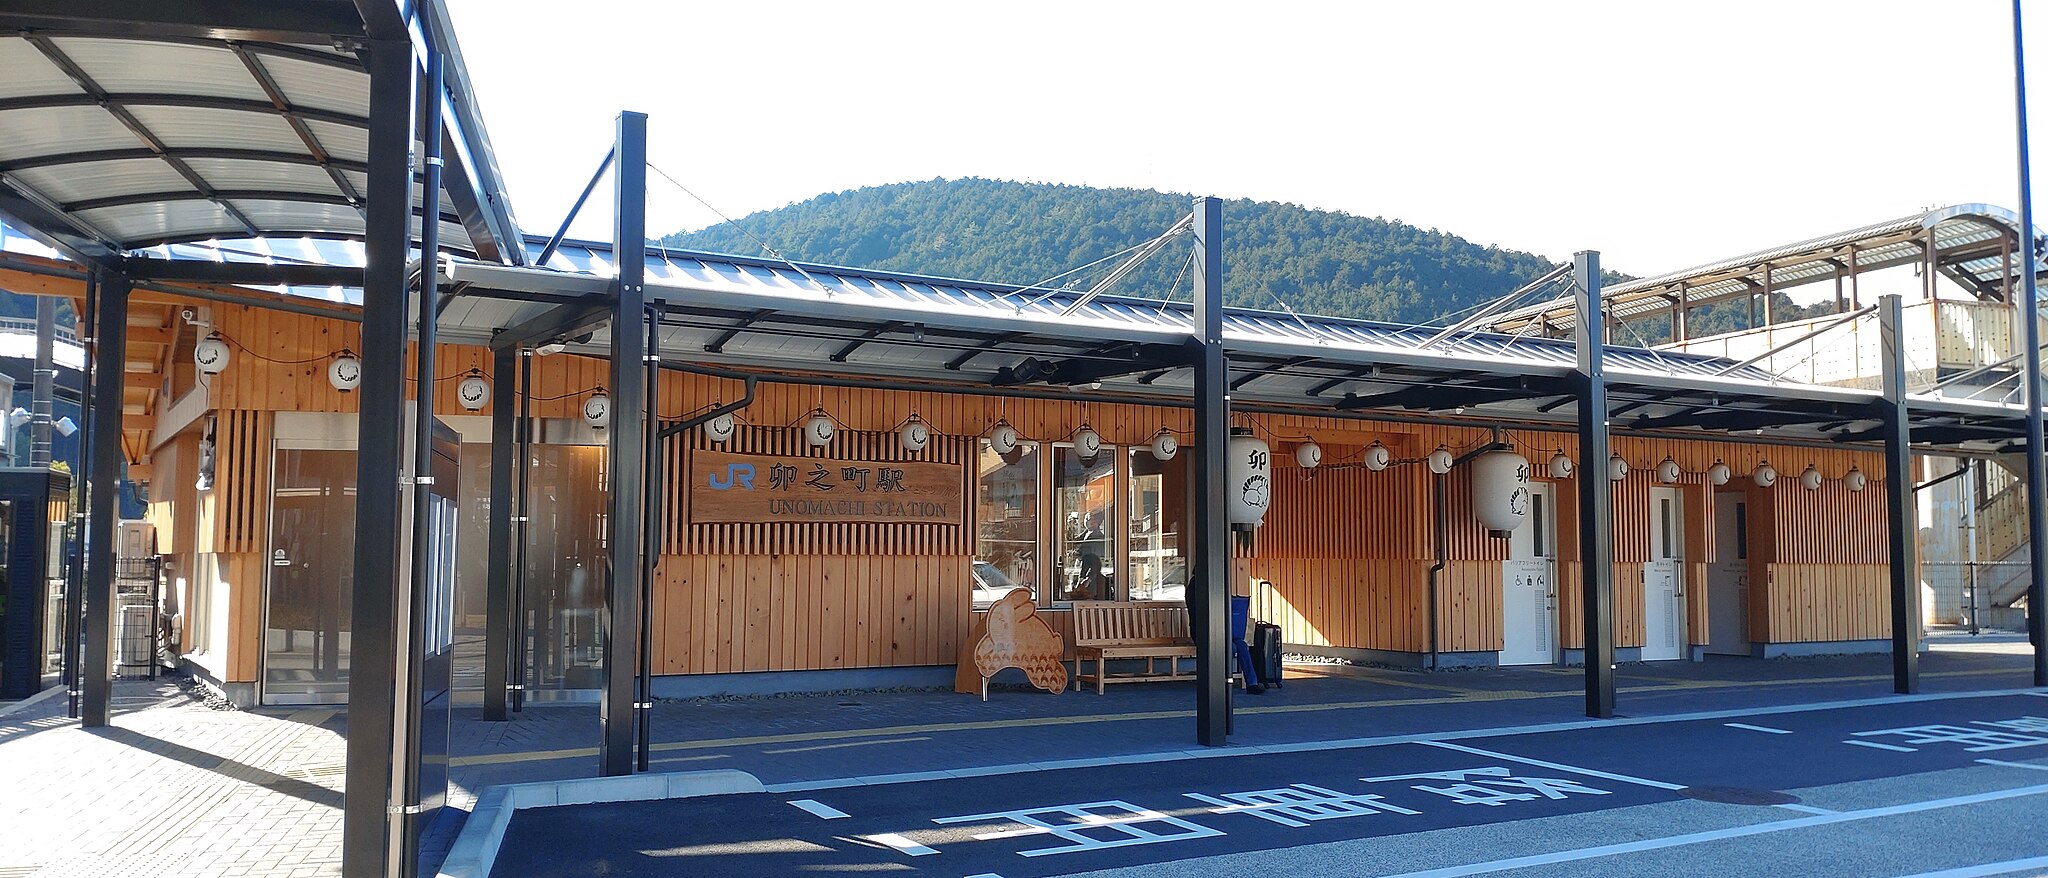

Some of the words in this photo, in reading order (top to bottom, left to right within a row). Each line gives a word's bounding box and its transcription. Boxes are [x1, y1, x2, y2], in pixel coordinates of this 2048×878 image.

[1248, 450, 1266, 471] 卯
[709, 463, 757, 492] JR
[769, 462, 907, 492] 卯之町駅
[1516, 464, 1529, 483] 卯
[769, 499, 866, 516] UNOMACHI
[874, 501, 947, 517] STATION
